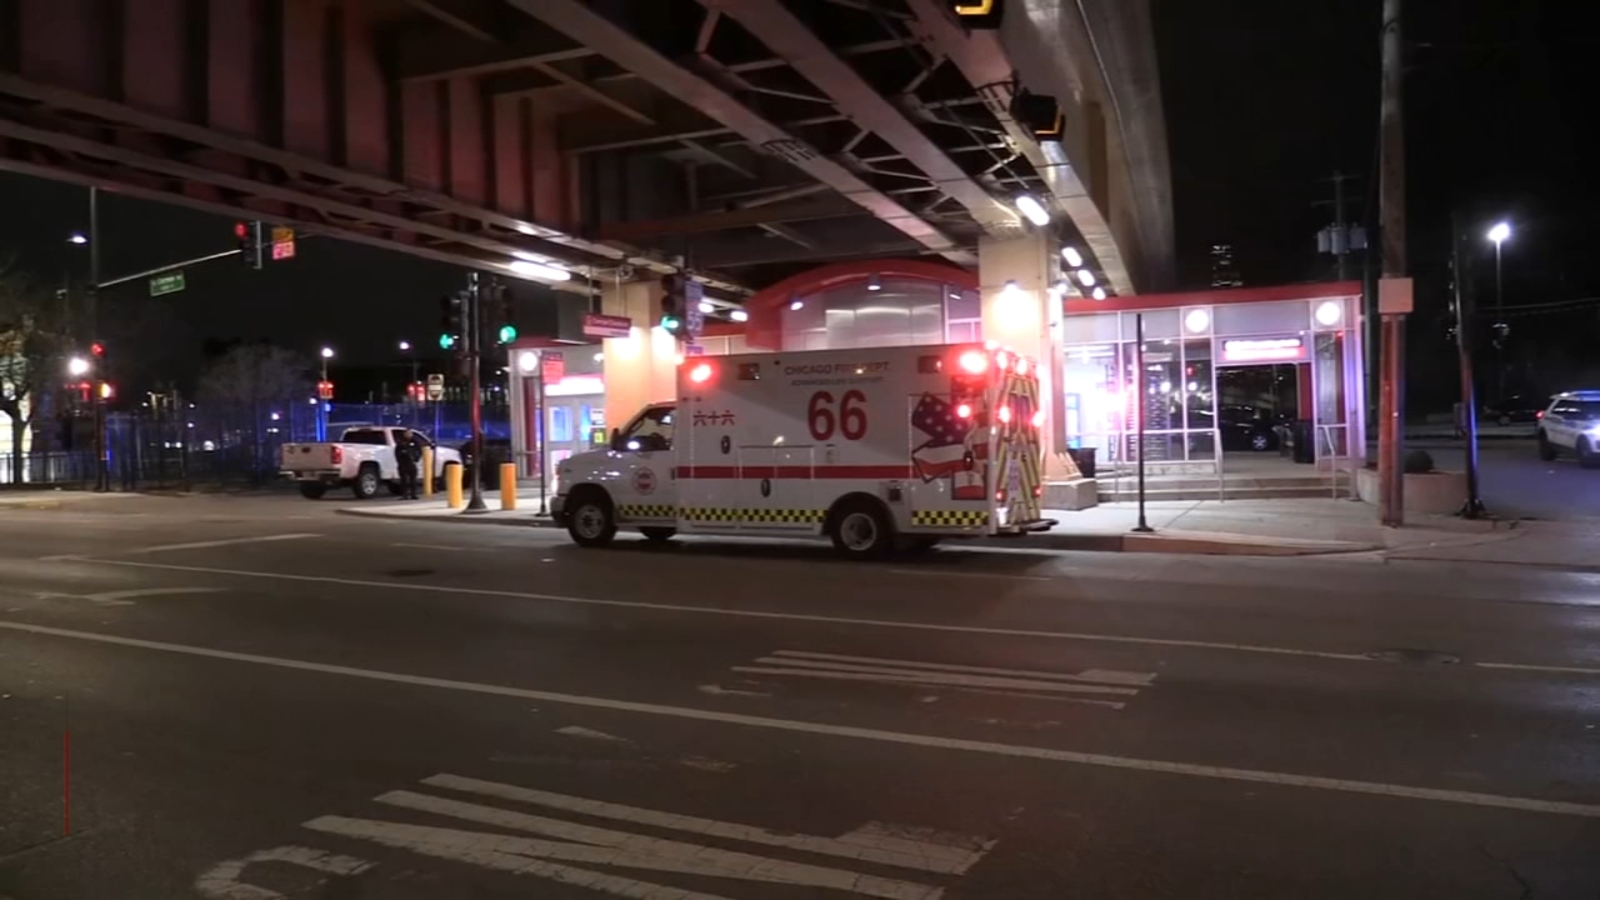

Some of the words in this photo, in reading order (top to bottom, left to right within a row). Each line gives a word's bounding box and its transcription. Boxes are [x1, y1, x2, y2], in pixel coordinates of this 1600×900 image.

[784, 364, 832, 375] CHICAGO
[693, 409, 735, 426] 六十六
[808, 389, 867, 441] 66
